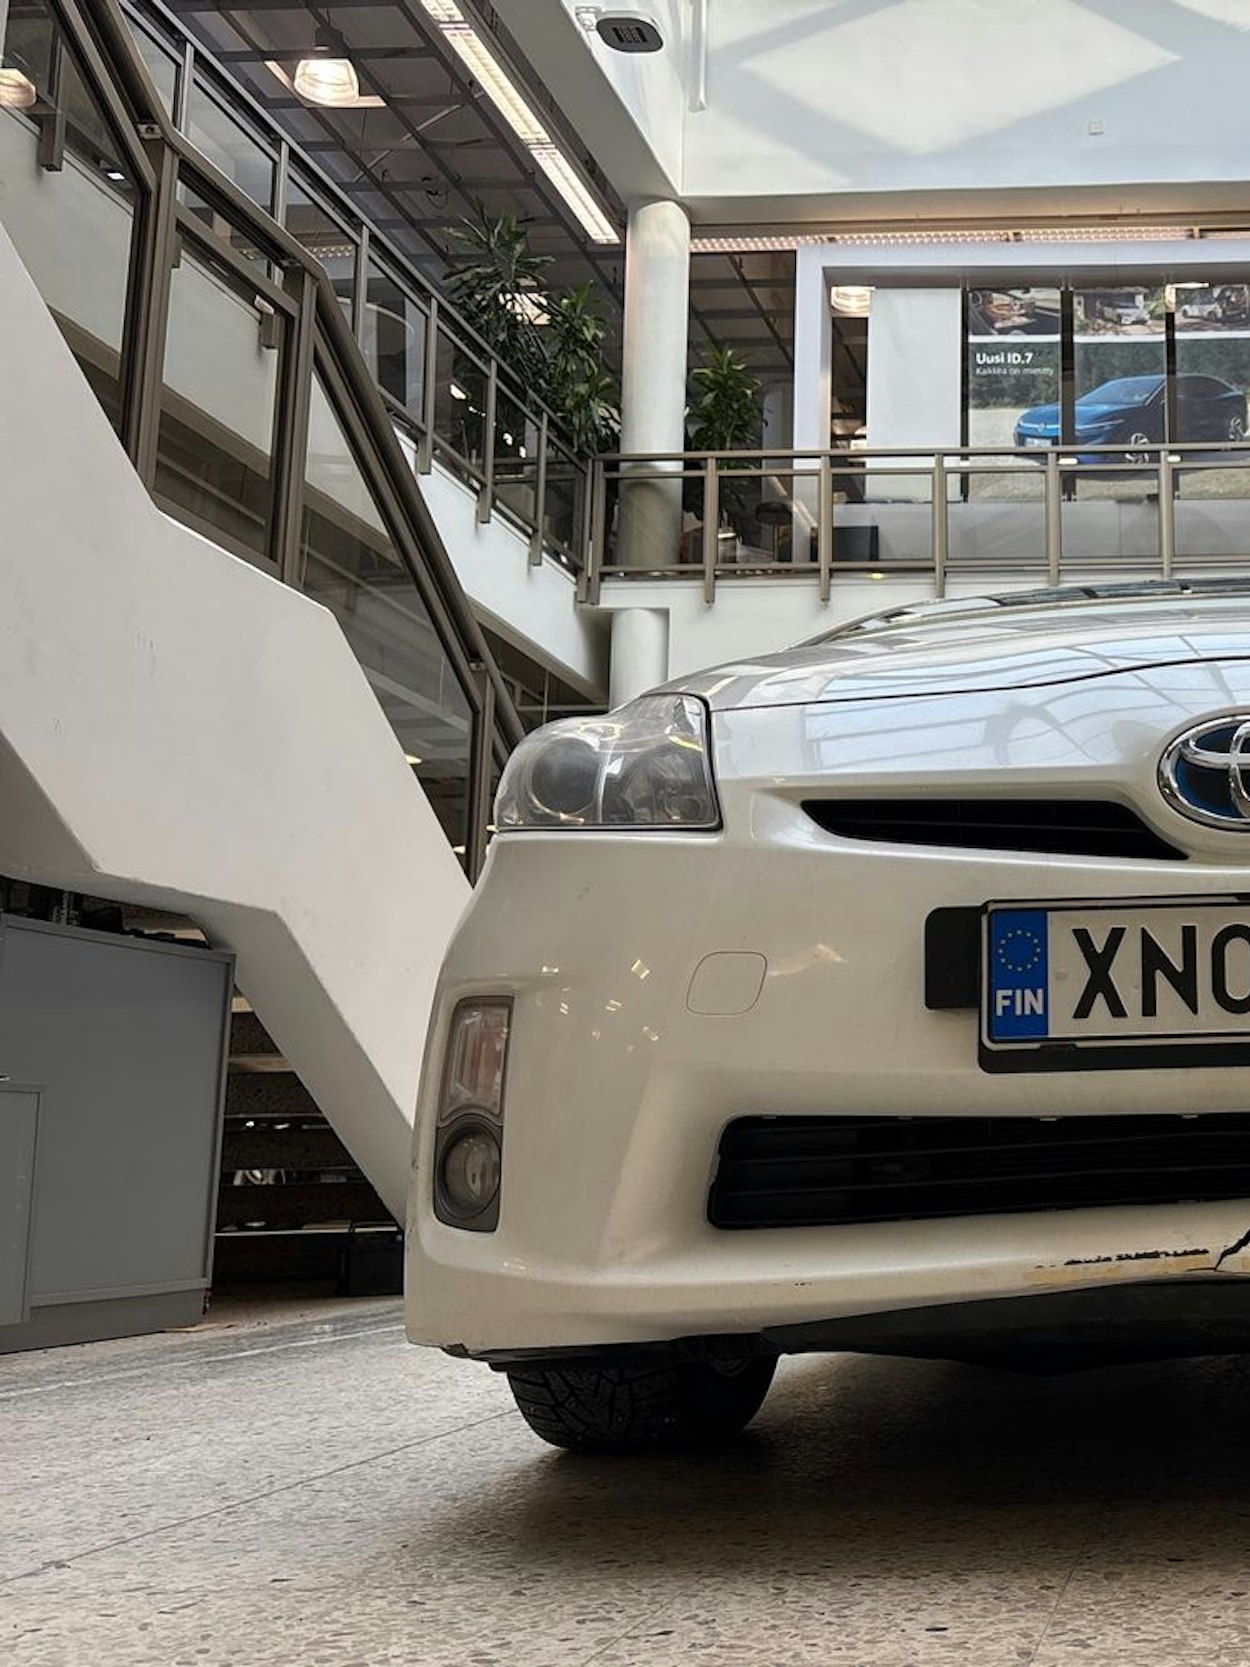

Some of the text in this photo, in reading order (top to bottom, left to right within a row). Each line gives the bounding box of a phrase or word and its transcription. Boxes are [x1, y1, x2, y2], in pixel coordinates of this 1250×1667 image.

[976, 352, 1034, 364] Uusi ID.7
[994, 987, 1045, 1017] FIN
